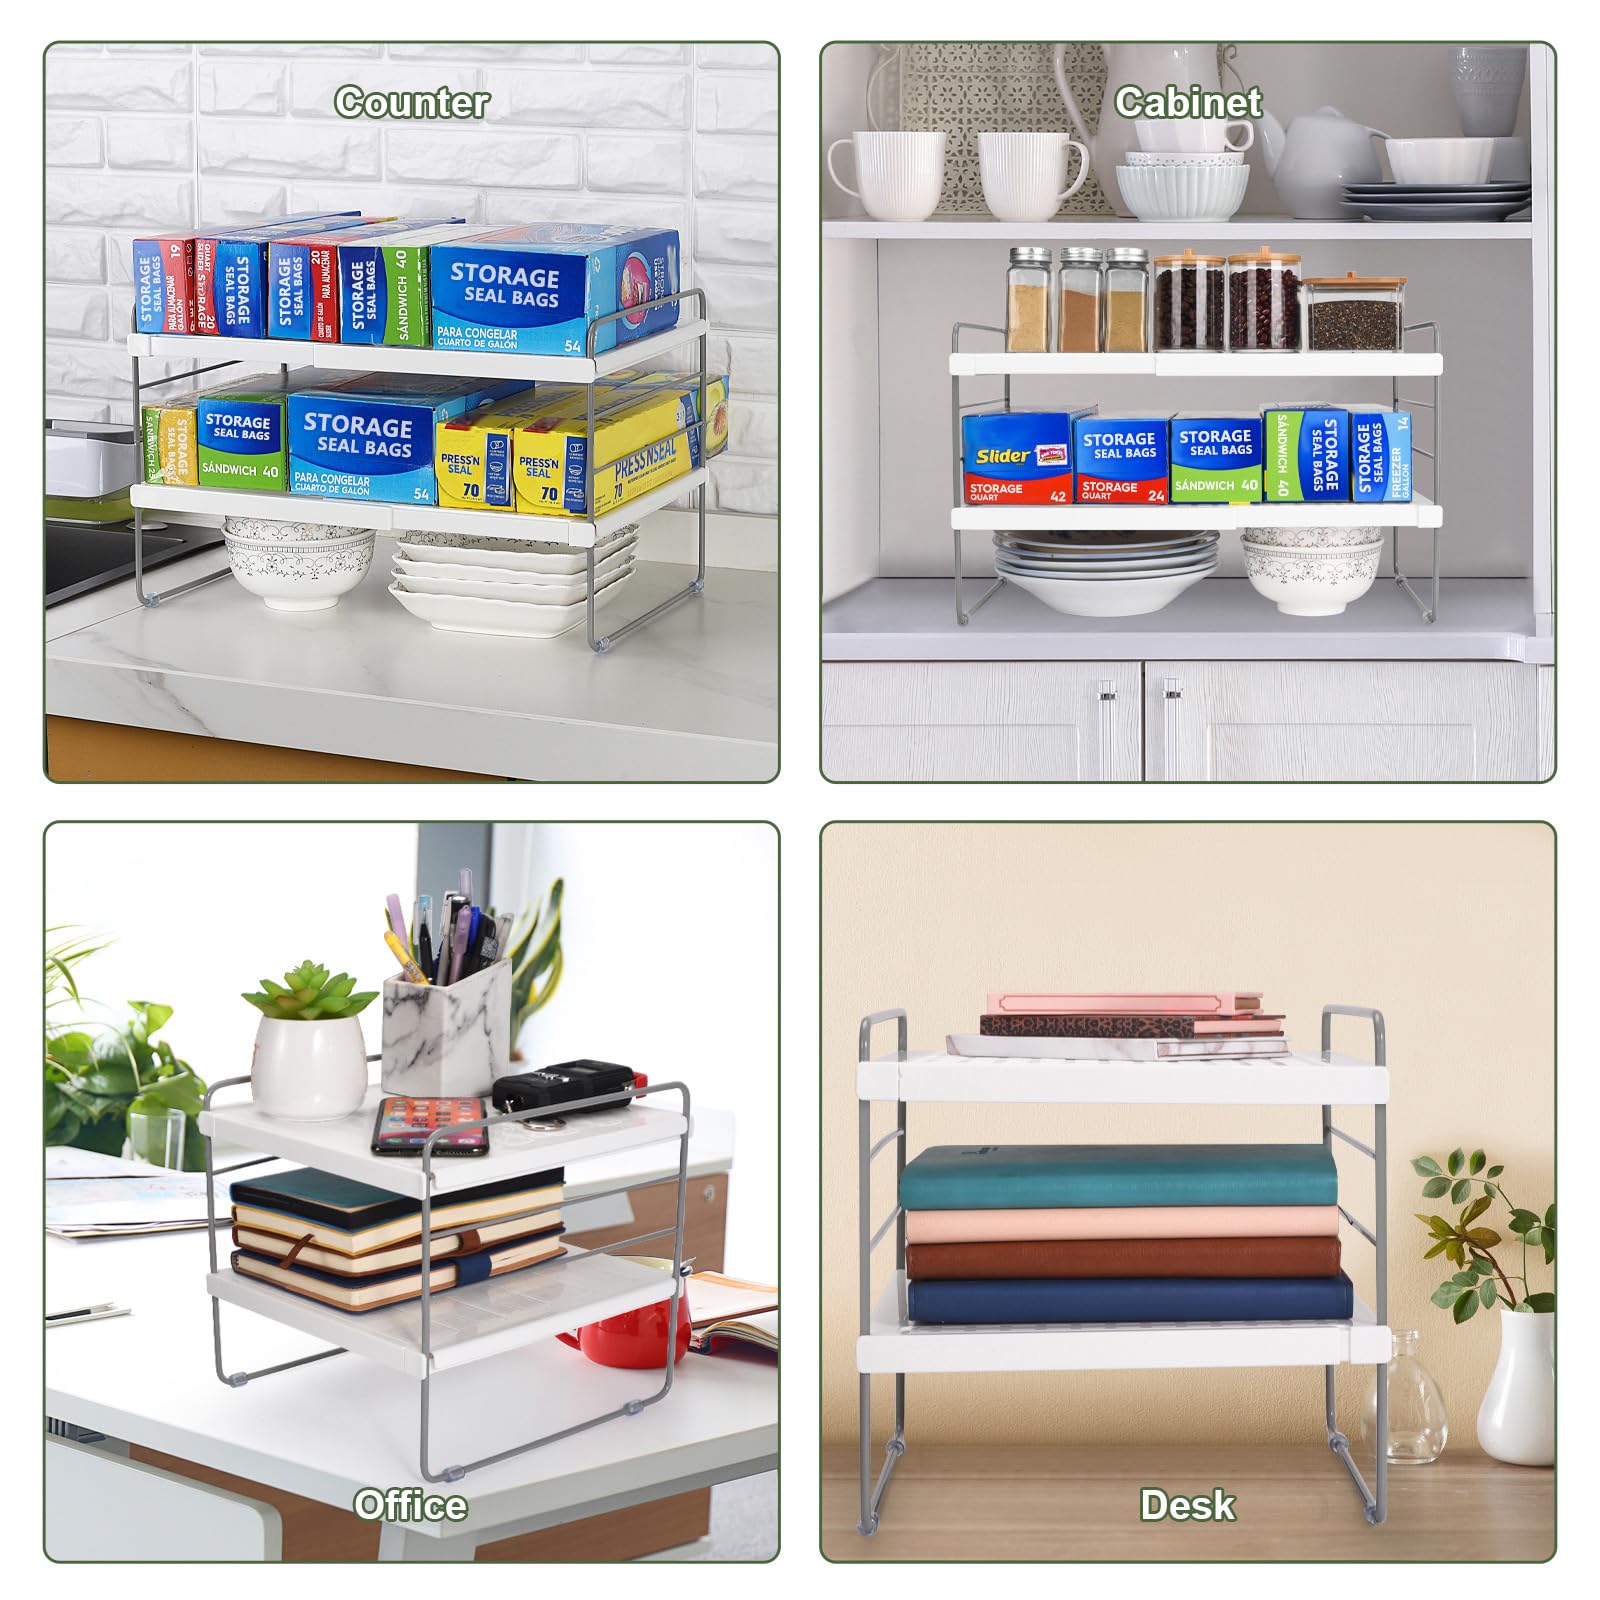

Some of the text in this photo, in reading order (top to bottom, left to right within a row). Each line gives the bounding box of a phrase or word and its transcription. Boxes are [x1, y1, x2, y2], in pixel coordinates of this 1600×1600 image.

[170, 244, 180, 258] 19
[311, 250, 320, 265] 20
[321, 250, 330, 299] PARA ALMACENAR
[450, 262, 560, 290] STORAGE
[139, 257, 151, 322] STORAGE
[152, 256, 162, 312] SEAL BAGS
[237, 256, 250, 324] STORAGE
[279, 258, 291, 326] STORAGE
[293, 257, 303, 316] SEAL BAGS
[366, 260, 377, 320] SEAL BAGS
[166, 275, 177, 330] PARA ALMACENAR
[225, 266, 236, 325] SEAL BAGS
[352, 262, 365, 330] STORAGE
[396, 250, 408, 340] SÁNDWICH 40
[464, 286, 559, 308] SEAL BAGS
[176, 299, 184, 331] GALÓN
[206, 315, 215, 329] 20
[437, 326, 518, 340] PARA CONGELAR
[438, 338, 518, 350] CUARTO DE GALÓN
[564, 340, 581, 353] 54
[205, 413, 270, 430] STORAGE
[303, 412, 413, 439] STORAGE
[1397, 416, 1408, 430] 14
[213, 427, 270, 441] SEAL BAGS
[1083, 432, 1155, 446] STORAGE
[1179, 429, 1252, 444] STORAGE
[167, 427, 176, 477] SEAL BAGS
[177, 419, 189, 475] STORAGE
[317, 436, 412, 458] SEAL BAGS
[1094, 448, 1157, 459] SEAL BAGS
[1190, 444, 1253, 456] SEAL BAGS
[1277, 414, 1289, 497] SÁNDWICH 40
[1324, 418, 1339, 491] STORAGE
[1372, 422, 1383, 483] SEAL BAGS
[975, 448, 1031, 465] Slider
[1312, 429, 1323, 492] SEAL BAGS
[1357, 423, 1371, 493] STORAGE
[202, 460, 279, 478] SÁNDWICH 40
[448, 464, 472, 475] SEAL
[526, 467, 551, 479] SEAL
[1391, 447, 1401, 498] FREEZER
[294, 471, 370, 487] PARA CONGELAR
[1082, 481, 1138, 493] STORAGE
[1175, 478, 1258, 491] SÁNDWICH 40
[1402, 463, 1410, 498] GALLON
[295, 483, 370, 496] CUARTO DE GALÓN
[413, 488, 430, 500] 54
[463, 483, 480, 497] 70
[541, 486, 558, 501] 70
[614, 482, 623, 500] 70
[970, 483, 1023, 494] STORAGE
[1050, 492, 1066, 502] 42
[1082, 492, 1111, 500] QUART
[1148, 491, 1165, 501] 24
[970, 494, 999, 502] QUART
